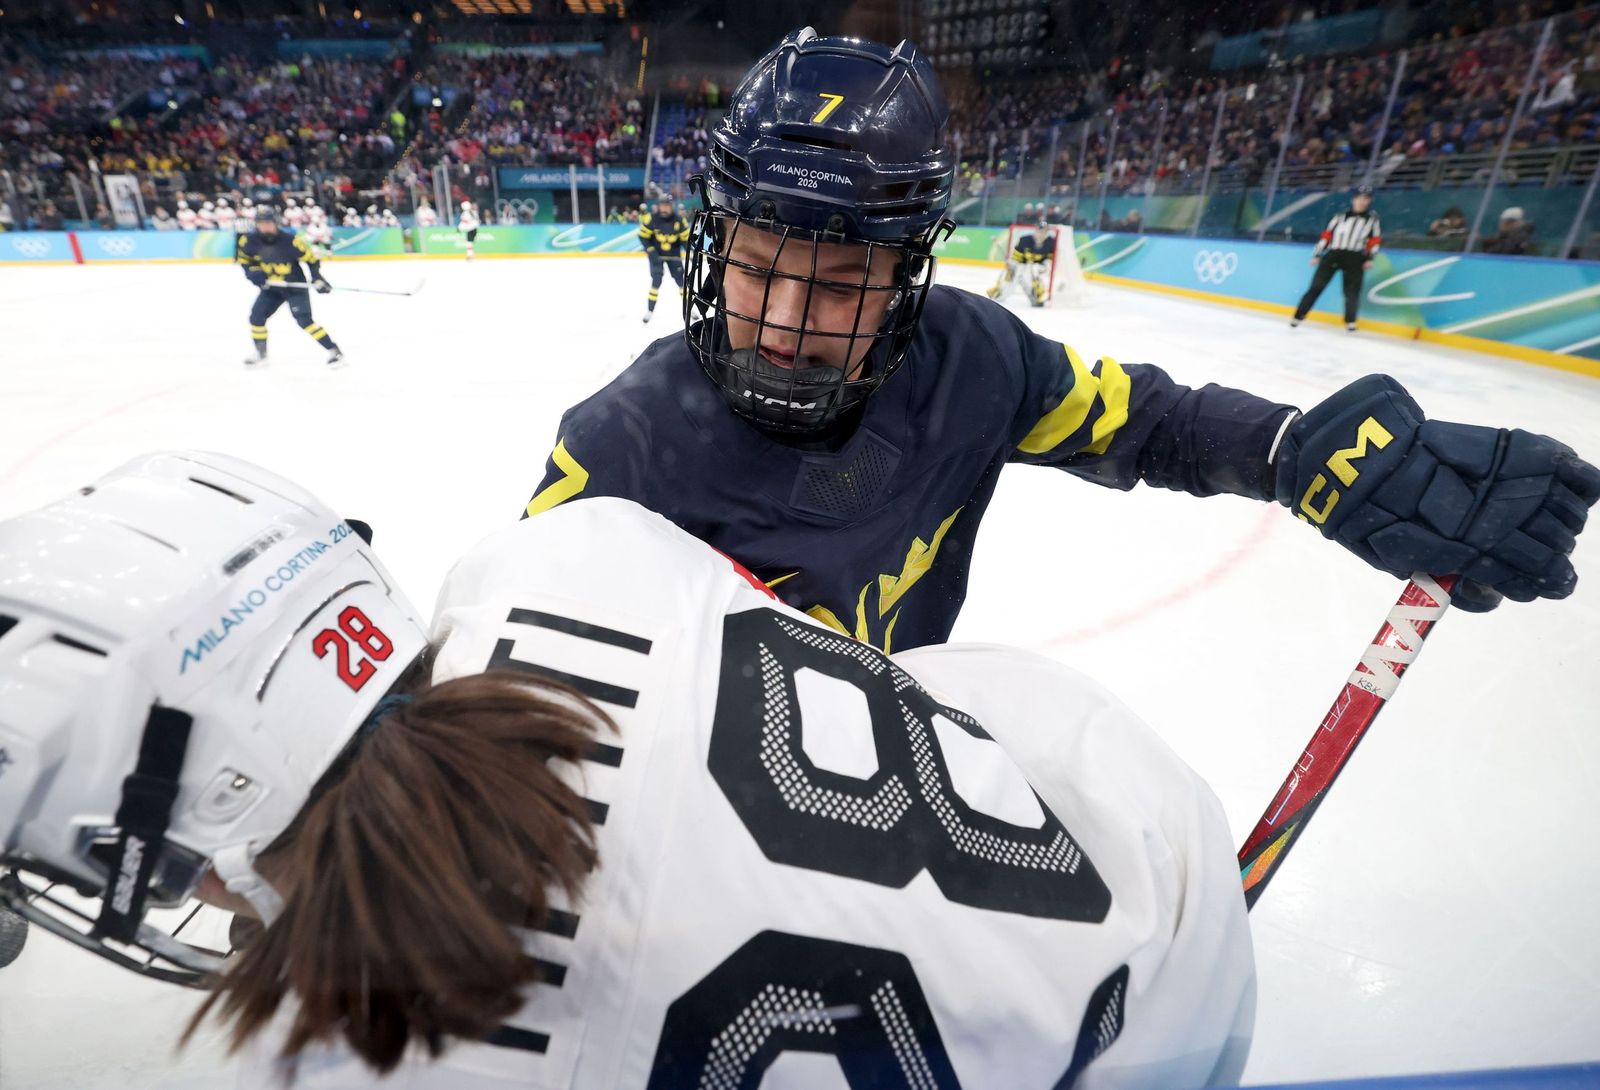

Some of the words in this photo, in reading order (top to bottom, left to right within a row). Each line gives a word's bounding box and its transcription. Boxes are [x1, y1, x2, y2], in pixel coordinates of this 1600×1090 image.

[810, 92, 846, 125] 7
[766, 163, 809, 177] MILANO
[809, 170, 854, 186] CORTINA
[797, 177, 818, 189] 2026
[1297, 415, 1394, 534] CM
[179, 590, 266, 676] MILANO
[264, 541, 333, 592] CORTINA
[312, 605, 394, 693] 28
[1358, 676, 1382, 695] KBK
